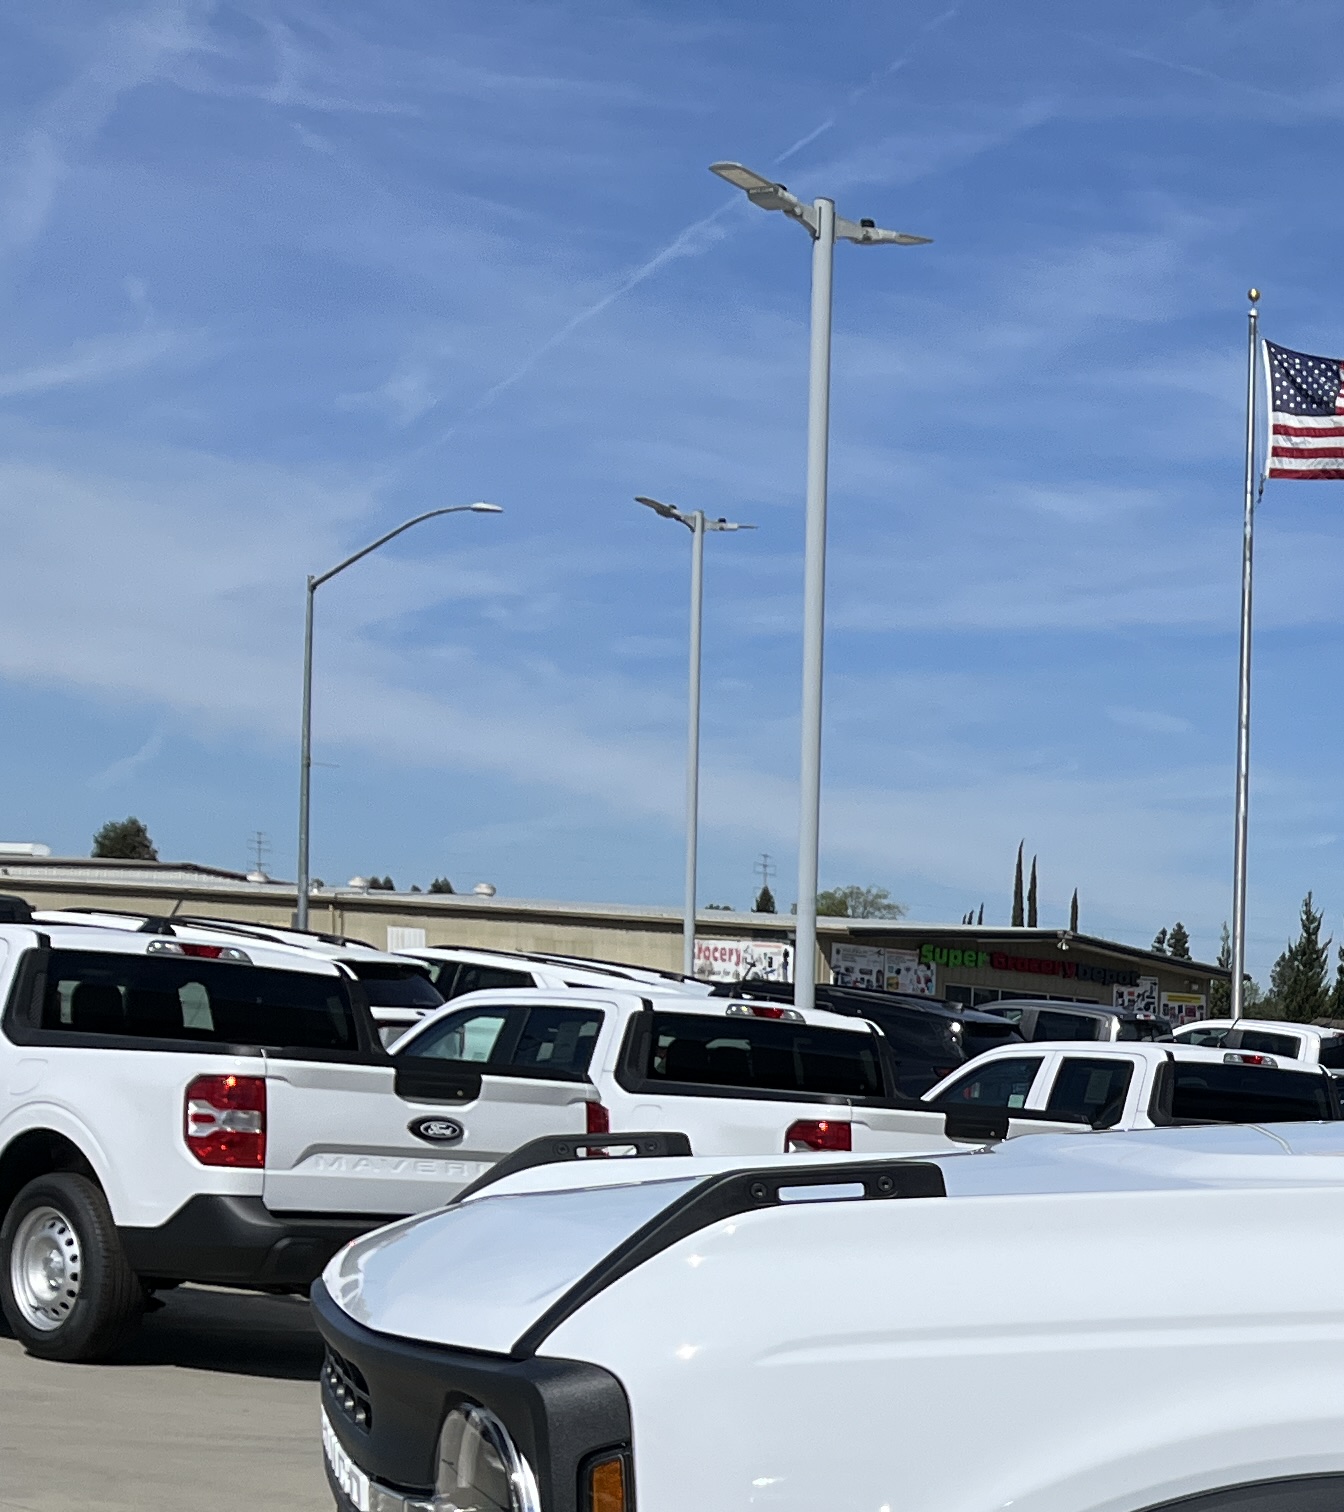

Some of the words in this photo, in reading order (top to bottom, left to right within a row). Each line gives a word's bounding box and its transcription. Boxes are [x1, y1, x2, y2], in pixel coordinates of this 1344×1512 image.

[696, 943, 742, 966] rocery
[920, 944, 989, 968] Super
[991, 952, 1077, 978] Grocery
[427, 1122, 453, 1136] Ford
[315, 1155, 486, 1177] MAVERI
